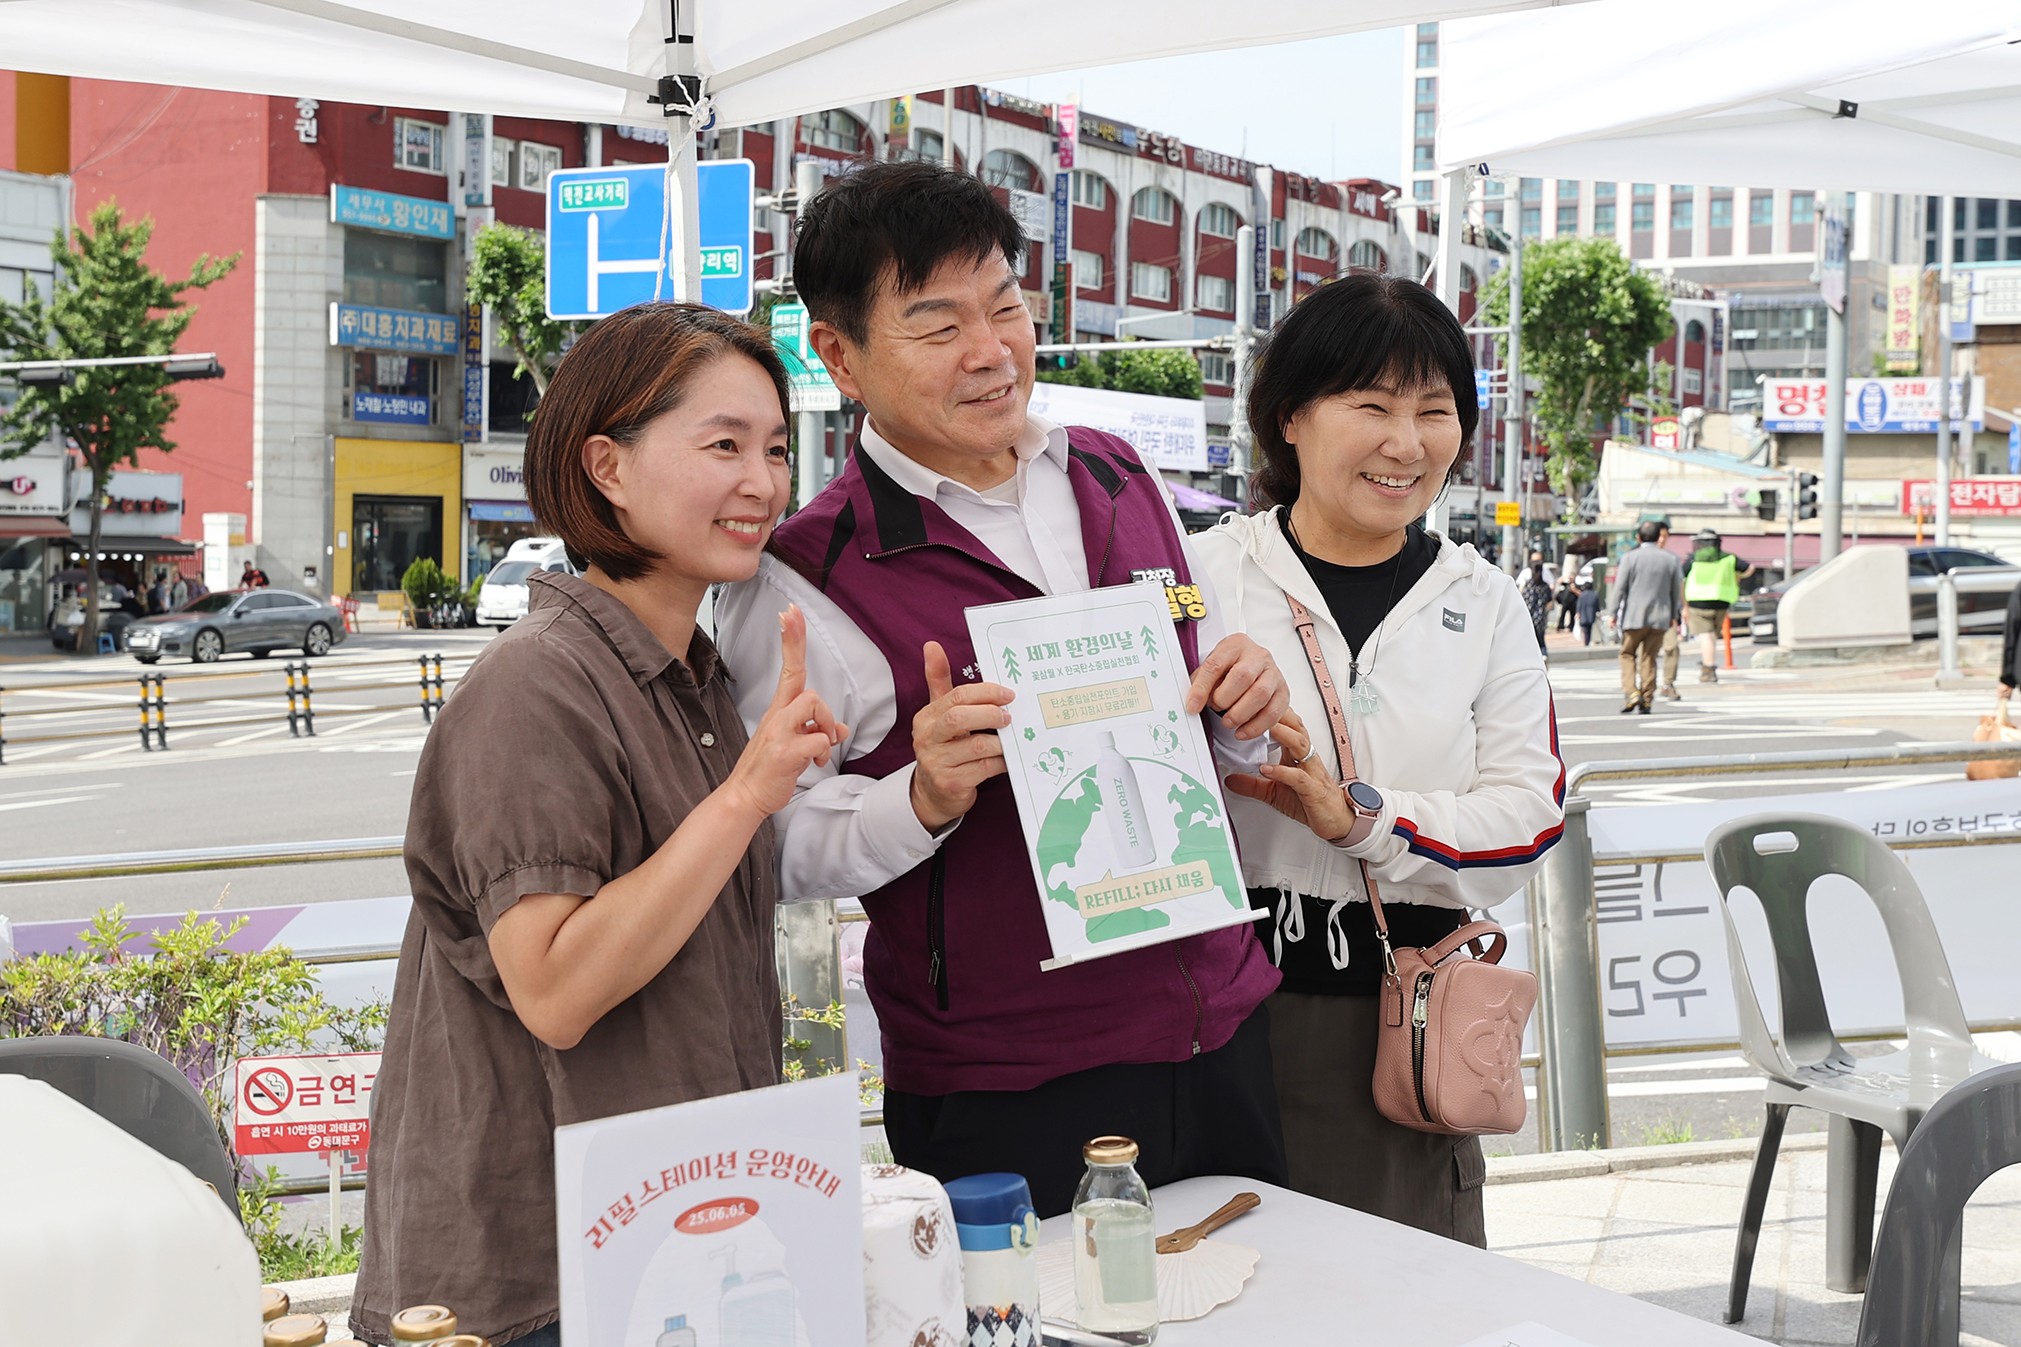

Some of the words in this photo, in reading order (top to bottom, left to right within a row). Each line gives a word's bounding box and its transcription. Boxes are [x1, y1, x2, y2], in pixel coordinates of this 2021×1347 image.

[563, 183, 625, 206] 떡전교사거리
[393, 199, 448, 233] 황인재
[1444, 613, 1463, 625] FILA
[1025, 642, 1062, 662] 세계
[1064, 630, 1134, 659] 환경의날
[1064, 654, 1140, 676] 한국탄소중립실천협회
[1050, 687, 1121, 709] 탄소중립실천포인트
[1113, 777, 1128, 808] ZERO
[1122, 809, 1140, 848] WASTE
[1143, 877, 1173, 896] 다시
[1176, 870, 1204, 888] 채움
[250, 1126, 271, 1139] 흡연
[273, 1125, 284, 1137] 시
[286, 1123, 327, 1136] 10만원의
[322, 1134, 360, 1148] 동대문구
[746, 1148, 842, 1199] 운영안내
[688, 1202, 746, 1228] 25.06.05
